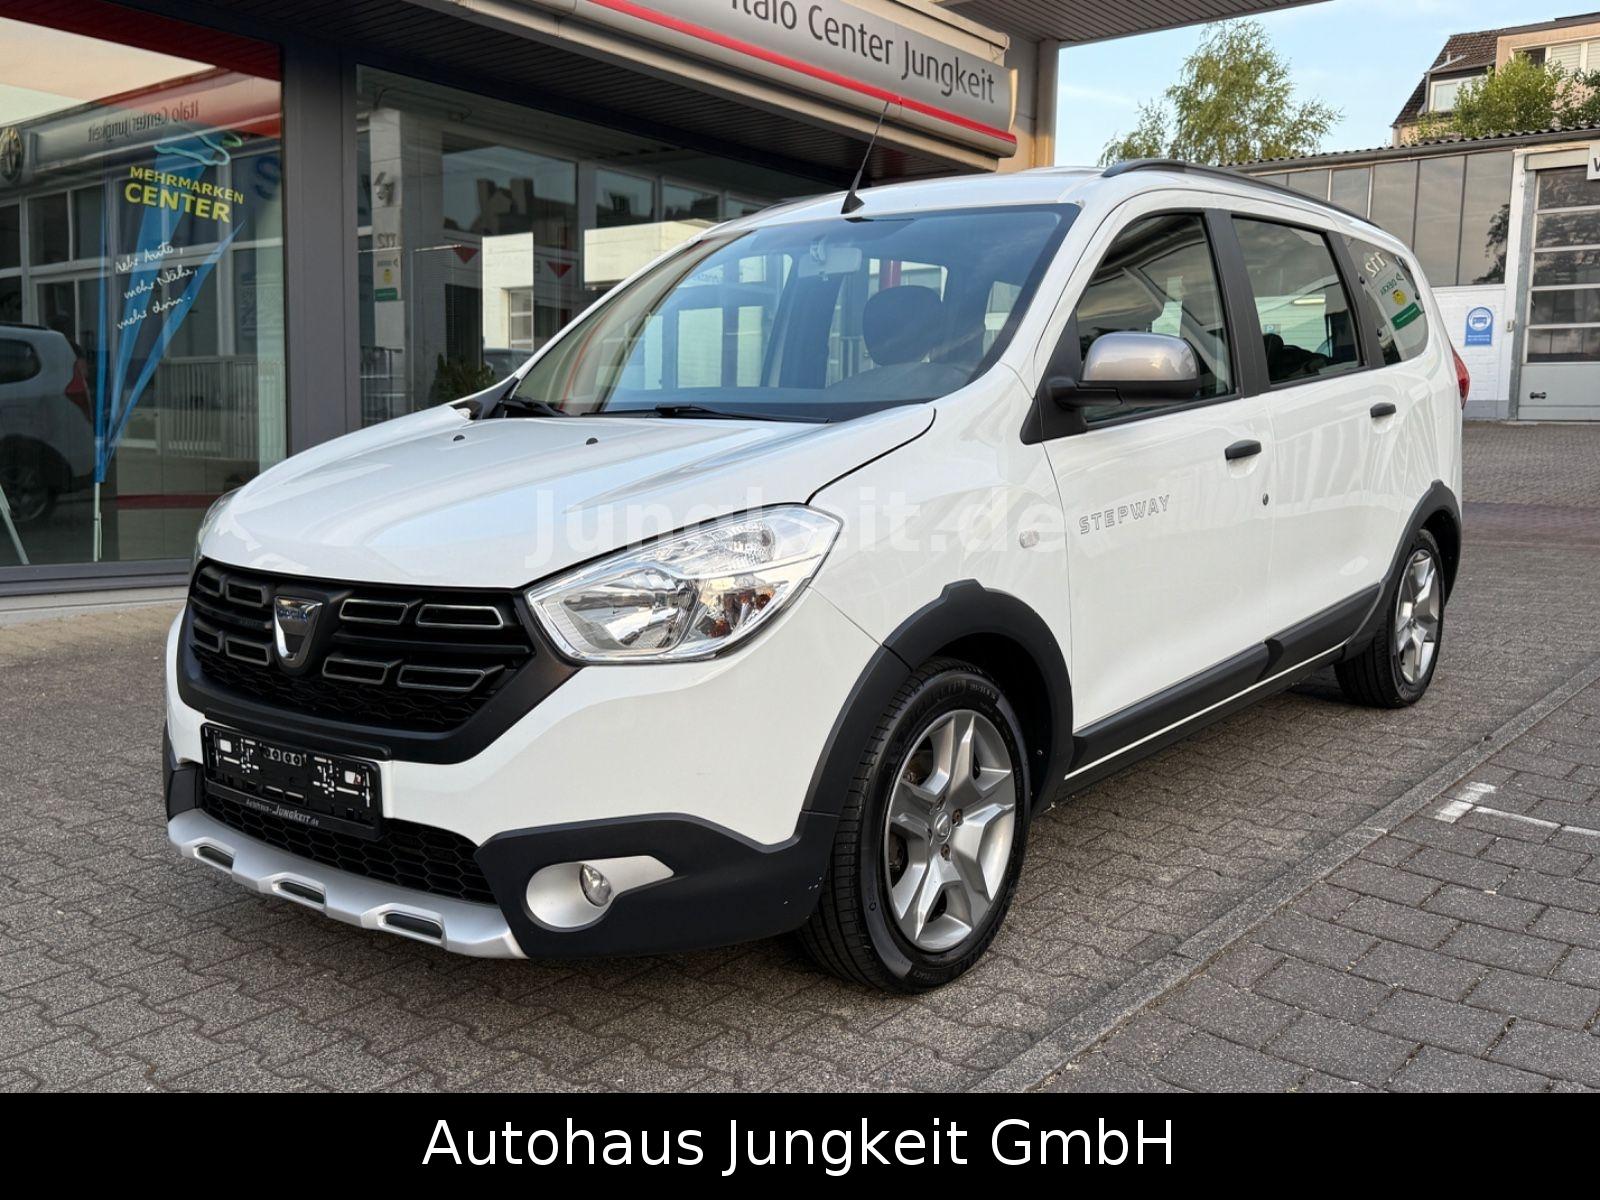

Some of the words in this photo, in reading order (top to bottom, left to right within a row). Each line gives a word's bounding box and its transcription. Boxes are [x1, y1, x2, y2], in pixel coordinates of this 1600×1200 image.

[733, 0, 798, 30] alo
[808, 4, 894, 64] Center
[901, 40, 995, 103] Jungkeit
[125, 183, 230, 223] CENTER
[130, 166, 244, 205] MEHRMARKEN
[1079, 494, 1170, 535] STEPWAY
